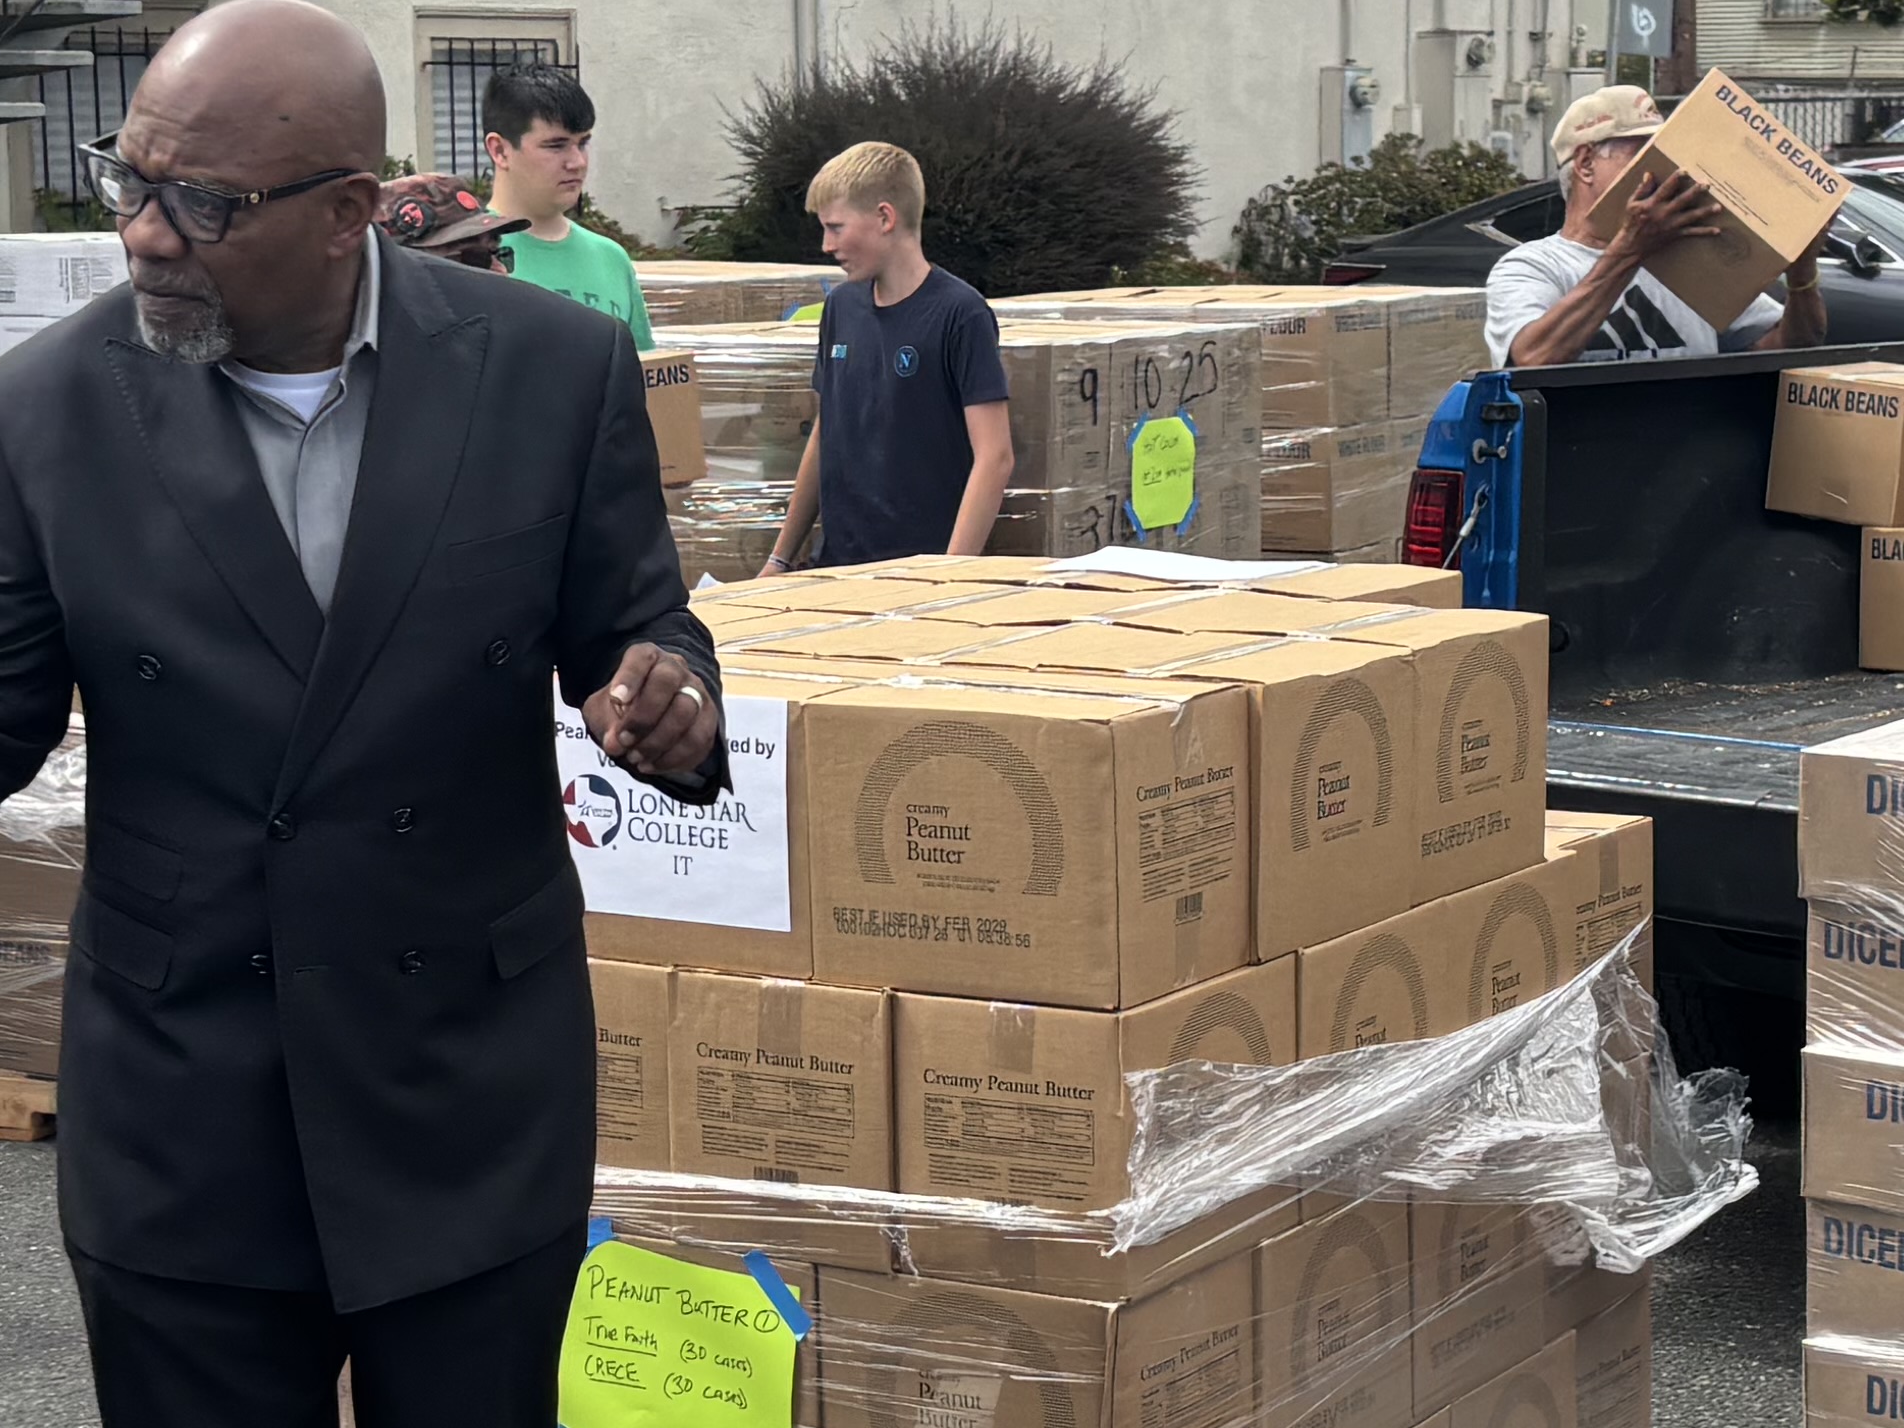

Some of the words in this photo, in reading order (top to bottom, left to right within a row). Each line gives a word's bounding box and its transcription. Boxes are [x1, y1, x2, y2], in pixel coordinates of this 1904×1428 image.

[1715, 85, 1777, 144] BLACK
[1776, 138, 1839, 195] BEANS
[642, 363, 689, 388] EANS
[1787, 382, 1840, 410] BLACK
[1845, 390, 1899, 418] BEANS
[555, 722, 590, 741] Pea
[755, 737, 776, 760] by
[1136, 783, 1173, 803] Creamy
[1174, 772, 1206, 793] Peanut
[627, 789, 689, 818] LONE
[695, 799, 758, 833] STAR
[905, 803, 951, 819] creamy
[627, 816, 730, 850] COLLEGE
[905, 816, 972, 841] Peanut
[673, 854, 694, 876] IT
[906, 840, 966, 864] Butter
[598, 1027, 643, 1048] Butter
[696, 1041, 752, 1067] Creamy
[756, 1048, 805, 1070] Peanut
[809, 1055, 855, 1076] Butter
[923, 1067, 983, 1094] Creamy
[987, 1074, 1041, 1096] Peanut
[1045, 1080, 1096, 1101] Butter
[587, 1264, 671, 1305] PEANUT
[584, 1354, 640, 1383] CRECE
[1140, 1358, 1177, 1382] Creamy
[918, 1381, 983, 1411] Peanut
